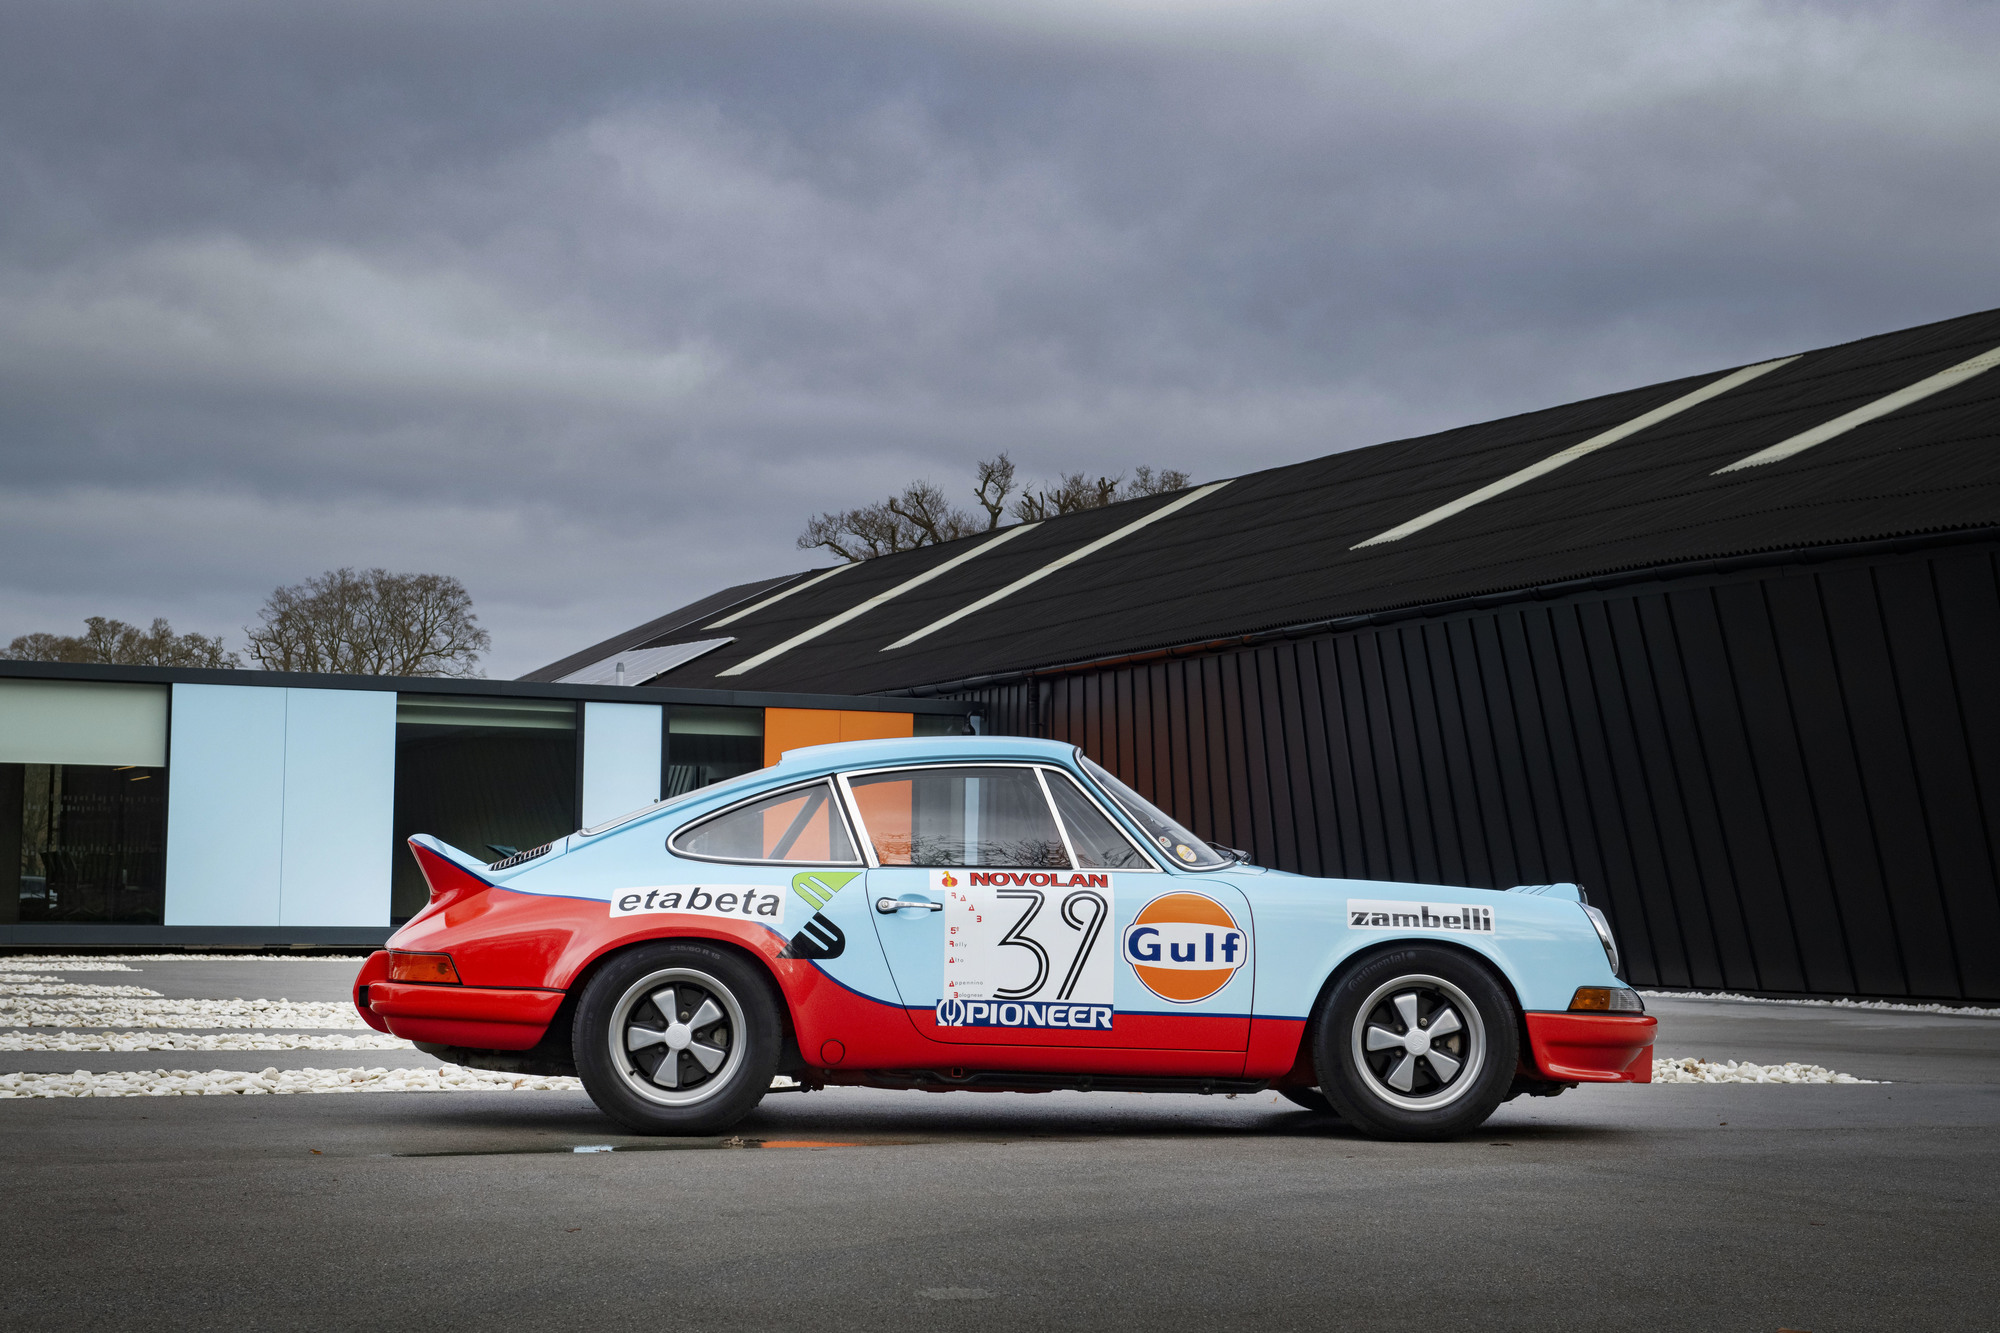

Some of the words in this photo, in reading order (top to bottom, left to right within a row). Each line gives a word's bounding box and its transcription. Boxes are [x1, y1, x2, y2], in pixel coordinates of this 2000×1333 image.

[969, 872, 1109, 888] NOVOLAN
[618, 887, 781, 916] etabeta
[1351, 905, 1491, 931] zambelli
[991, 889, 1109, 1001] 39
[1128, 927, 1240, 962] Gulf
[949, 956, 964, 964] Alto
[953, 991, 983, 999] Bolognese
[966, 1002, 1113, 1029] PIONEER
